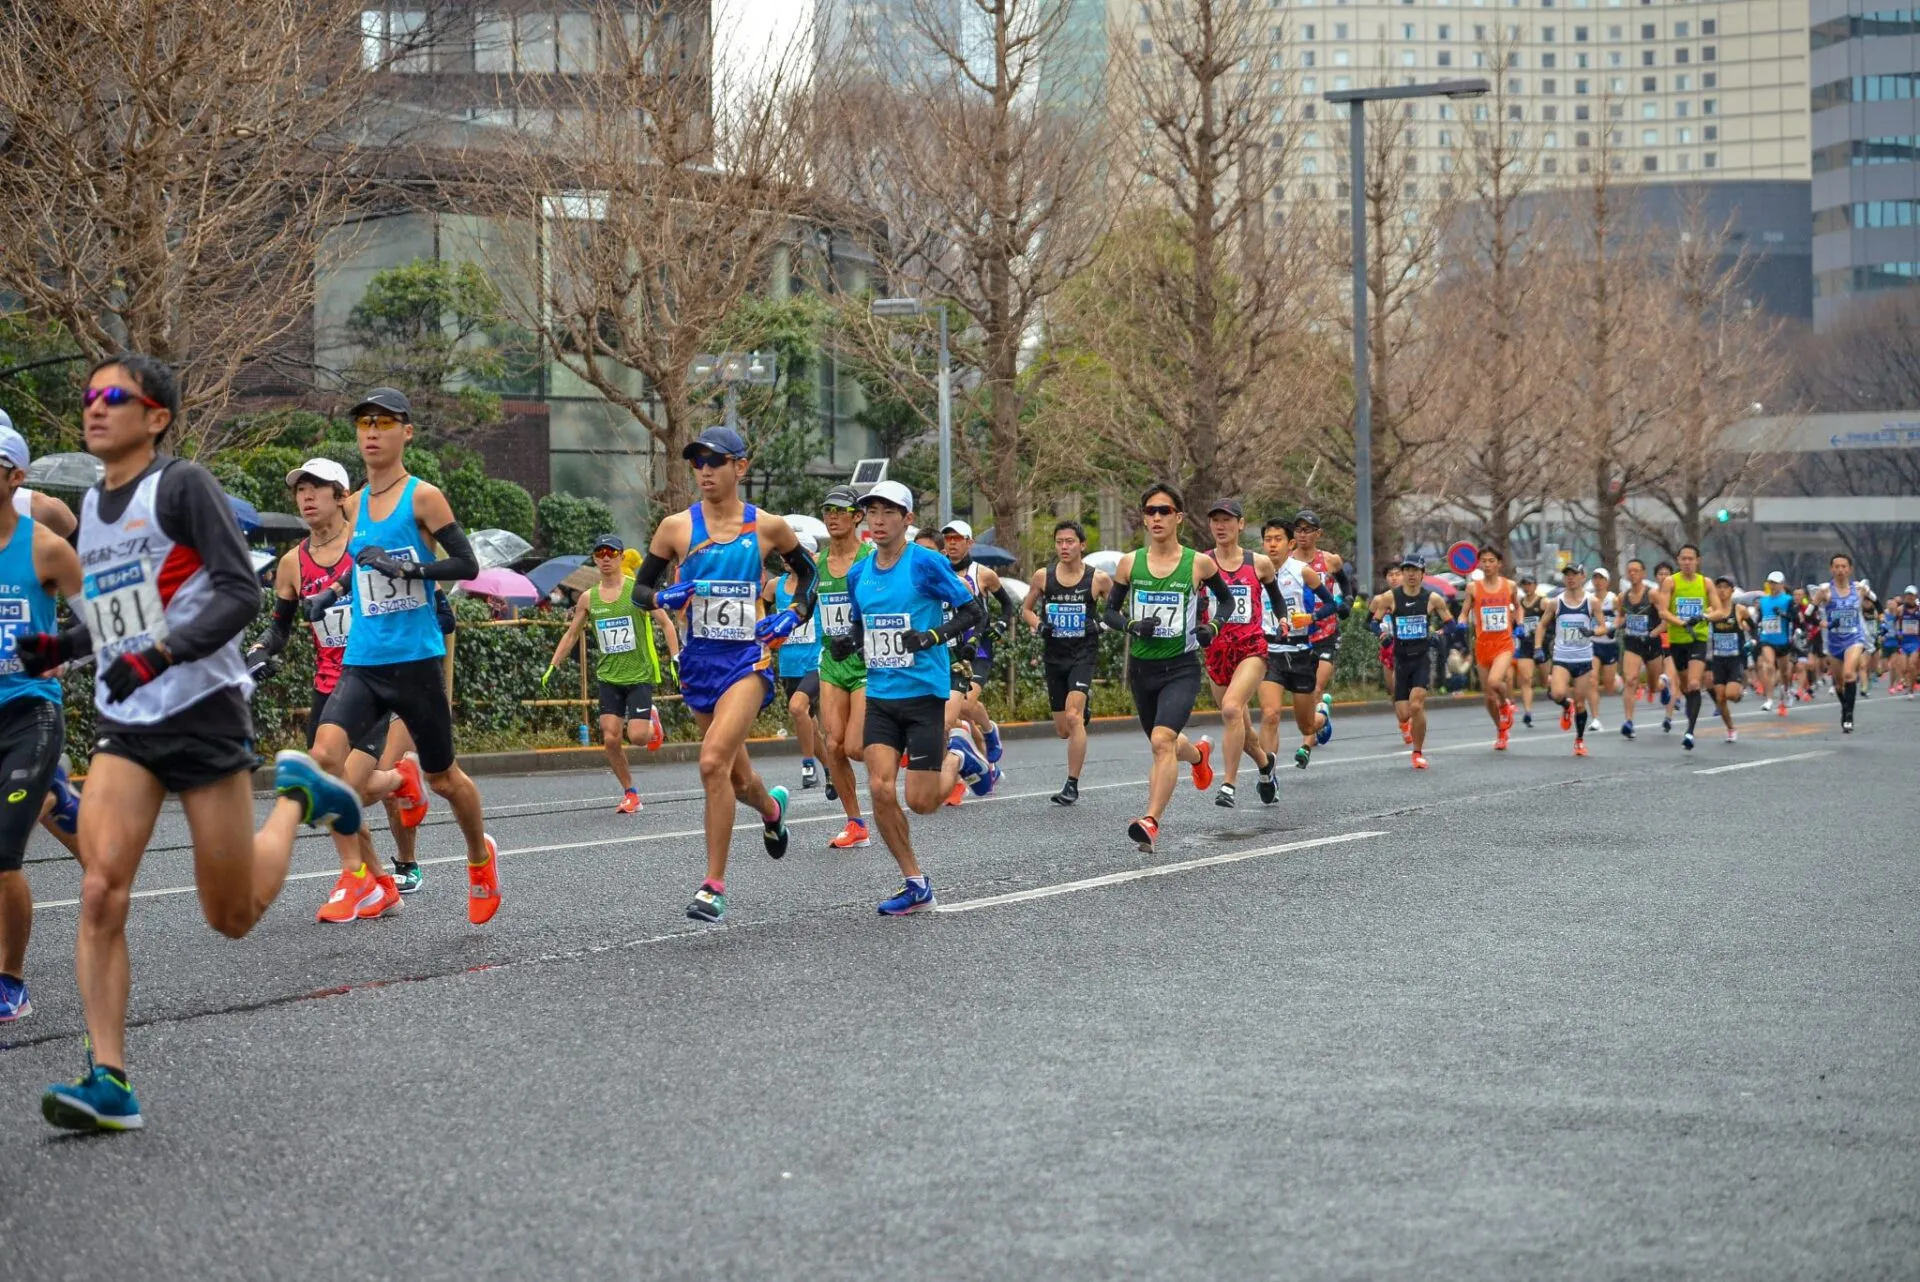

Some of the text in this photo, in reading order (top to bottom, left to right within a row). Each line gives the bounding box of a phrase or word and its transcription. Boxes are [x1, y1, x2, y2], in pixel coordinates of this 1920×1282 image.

[93, 589, 146, 643] 181
[703, 599, 744, 627] 161
[602, 627, 630, 646] 172
[871, 630, 906, 656] 130
